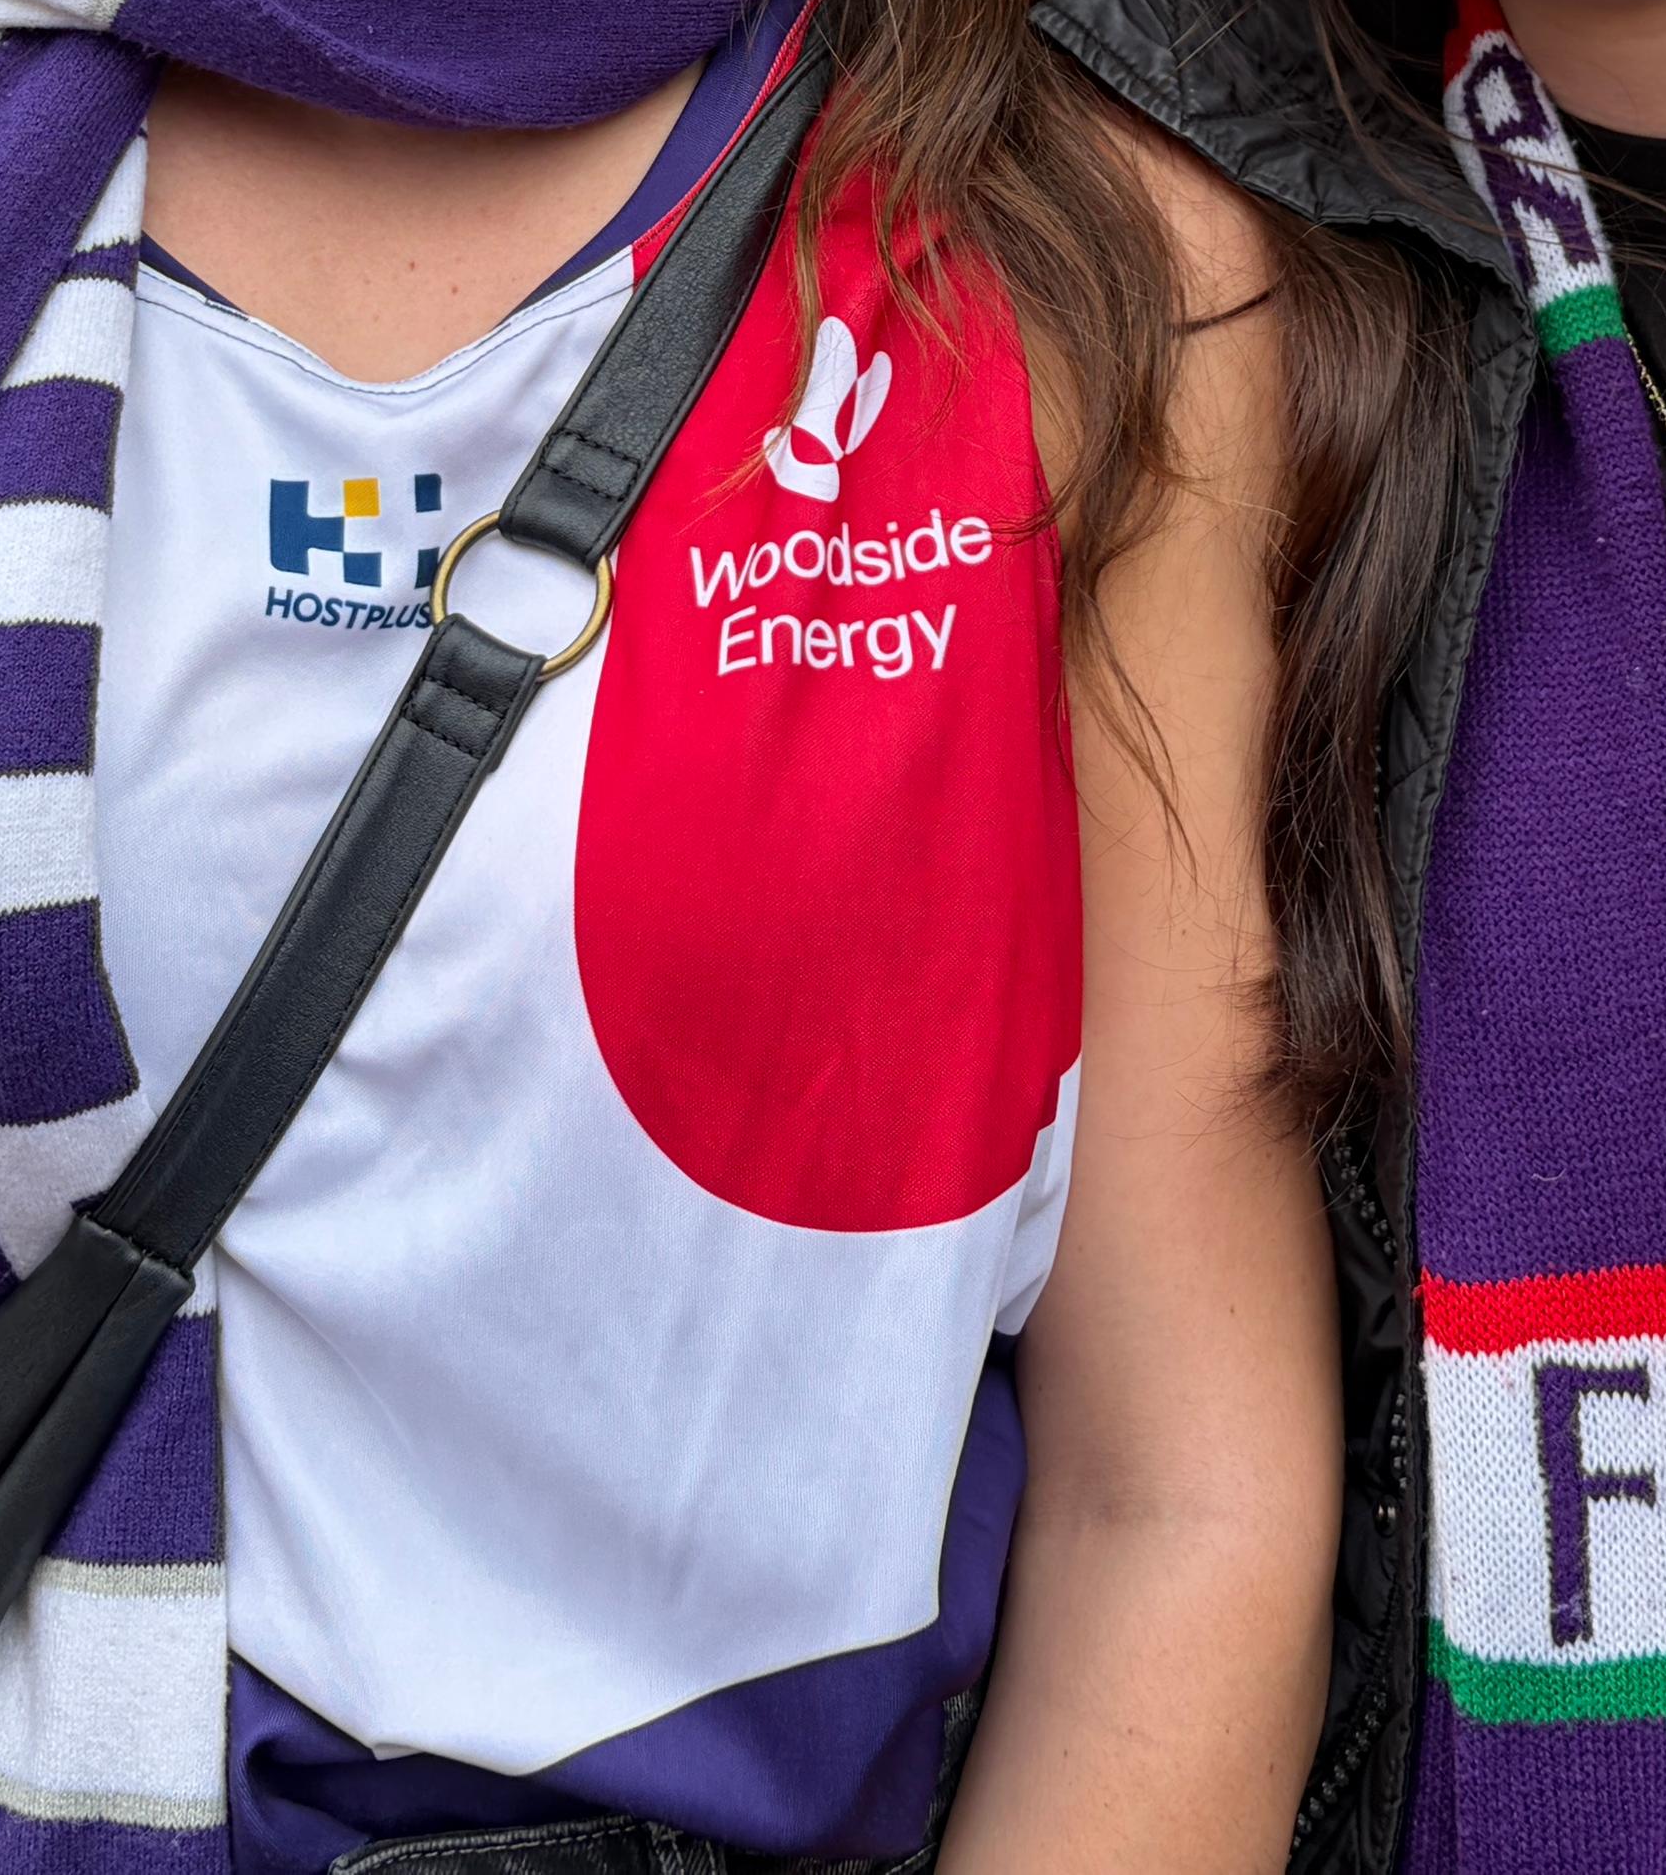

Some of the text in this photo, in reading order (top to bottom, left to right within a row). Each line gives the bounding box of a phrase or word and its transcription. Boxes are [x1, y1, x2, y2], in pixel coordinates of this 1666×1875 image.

[689, 507, 993, 609] Woodside
[265, 585, 435, 631] HOSTPLUS
[717, 603, 958, 680] Energy
